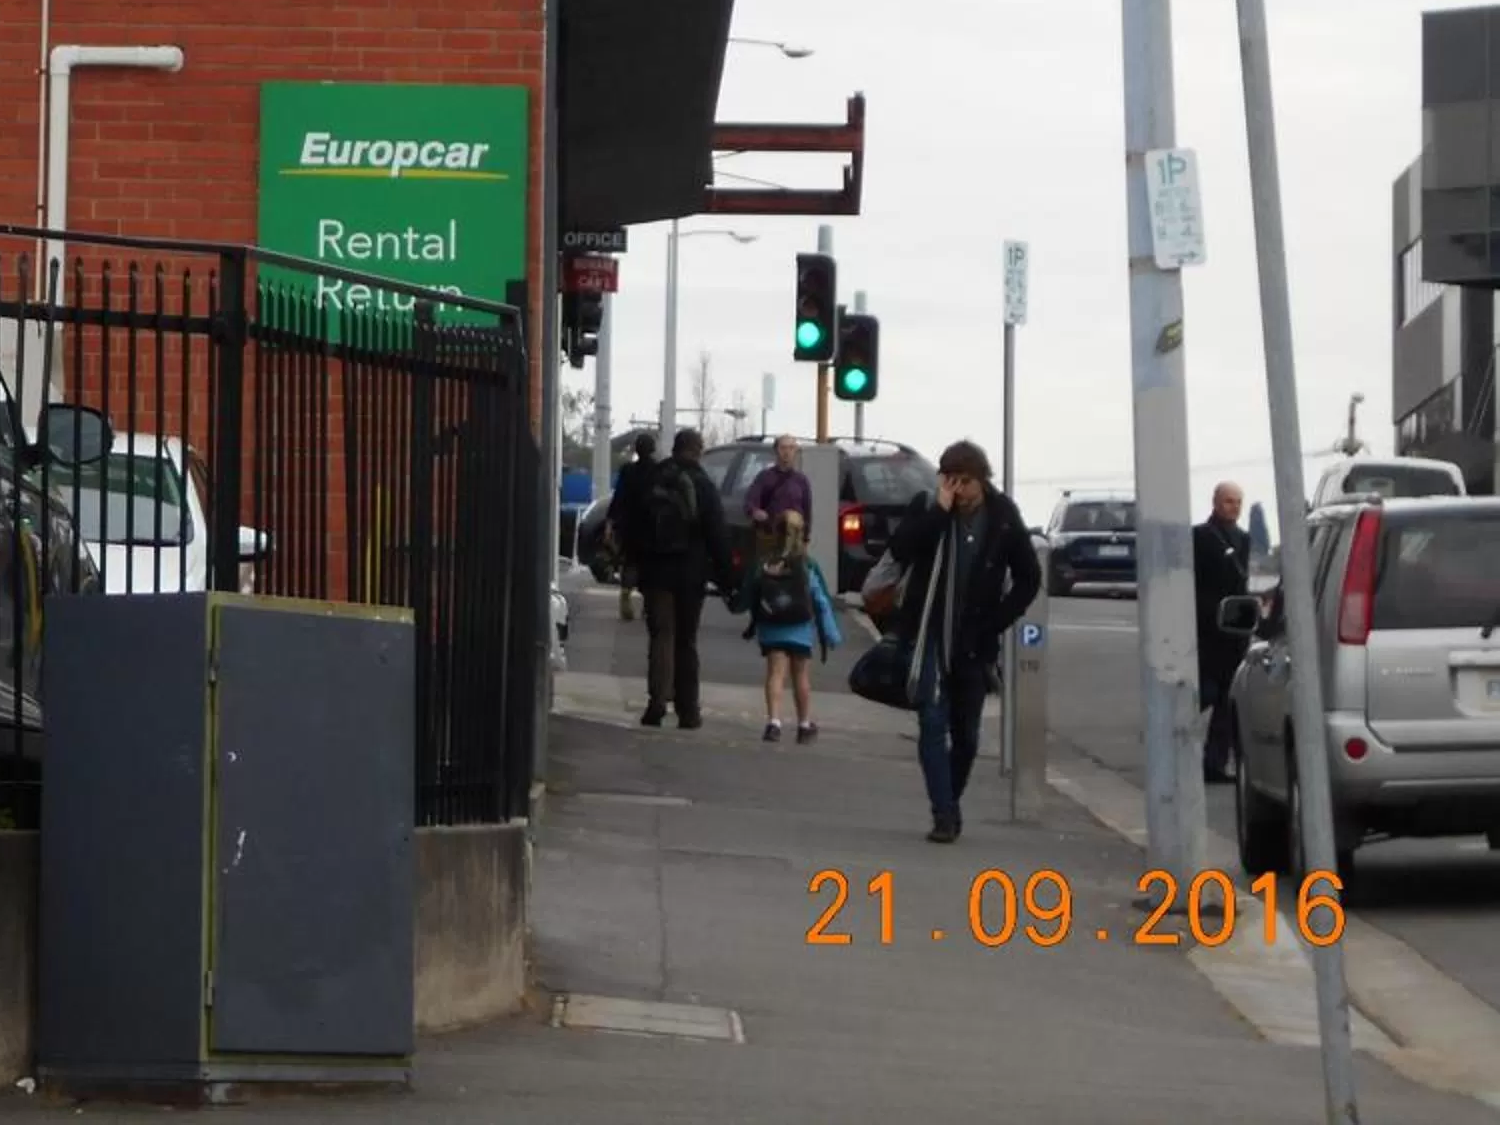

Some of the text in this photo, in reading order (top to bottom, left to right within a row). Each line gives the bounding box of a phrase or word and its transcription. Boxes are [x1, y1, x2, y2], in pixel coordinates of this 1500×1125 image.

[300, 131, 490, 178] Europcar
[1156, 152, 1187, 185] 1P
[317, 218, 457, 261] Rental
[315, 274, 464, 312] Retun
[1023, 624, 1040, 645] P
